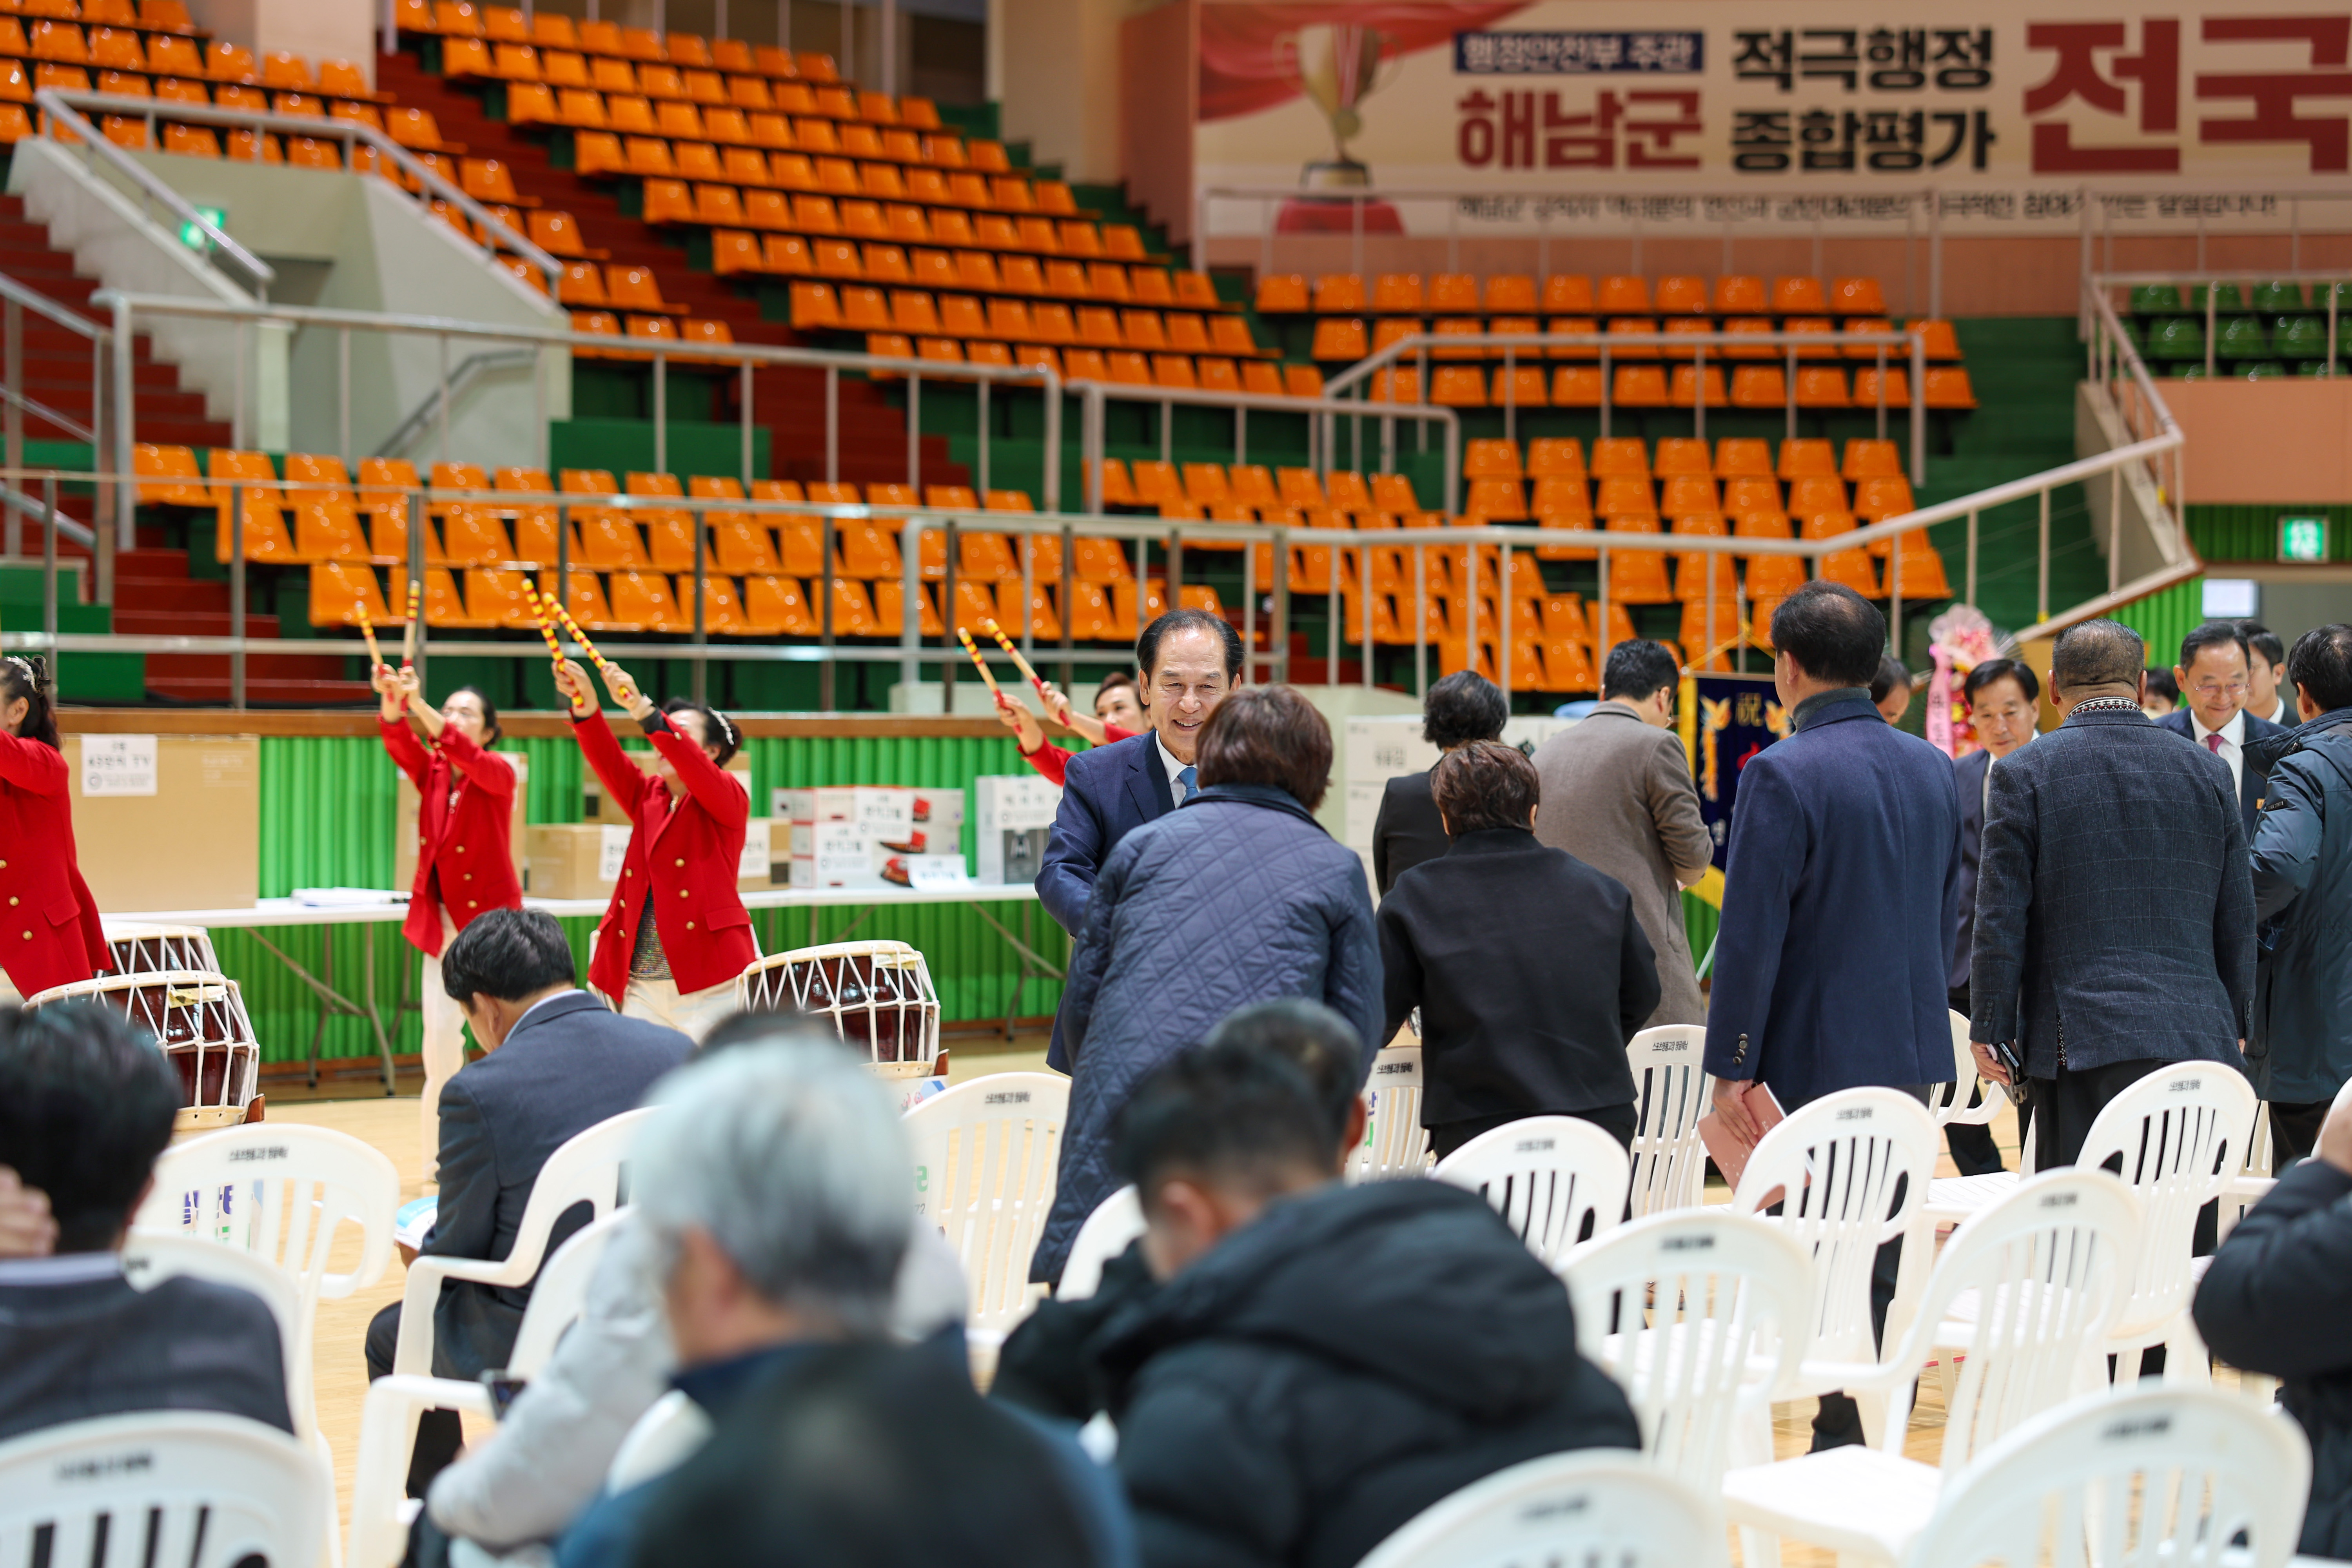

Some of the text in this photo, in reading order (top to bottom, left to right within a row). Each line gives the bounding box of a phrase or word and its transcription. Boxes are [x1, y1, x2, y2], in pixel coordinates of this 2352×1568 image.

[1628, 33, 1696, 72] 주관
[1733, 27, 1992, 93] 적극행정
[2023, 17, 2352, 175] 전국
[1458, 90, 1702, 169] 해남군
[1732, 109, 1997, 170] 종합평가
[1376, 1063, 1399, 1074] 스포츠명품고장
[1652, 1042, 1675, 1051] 스포츠명품고장
